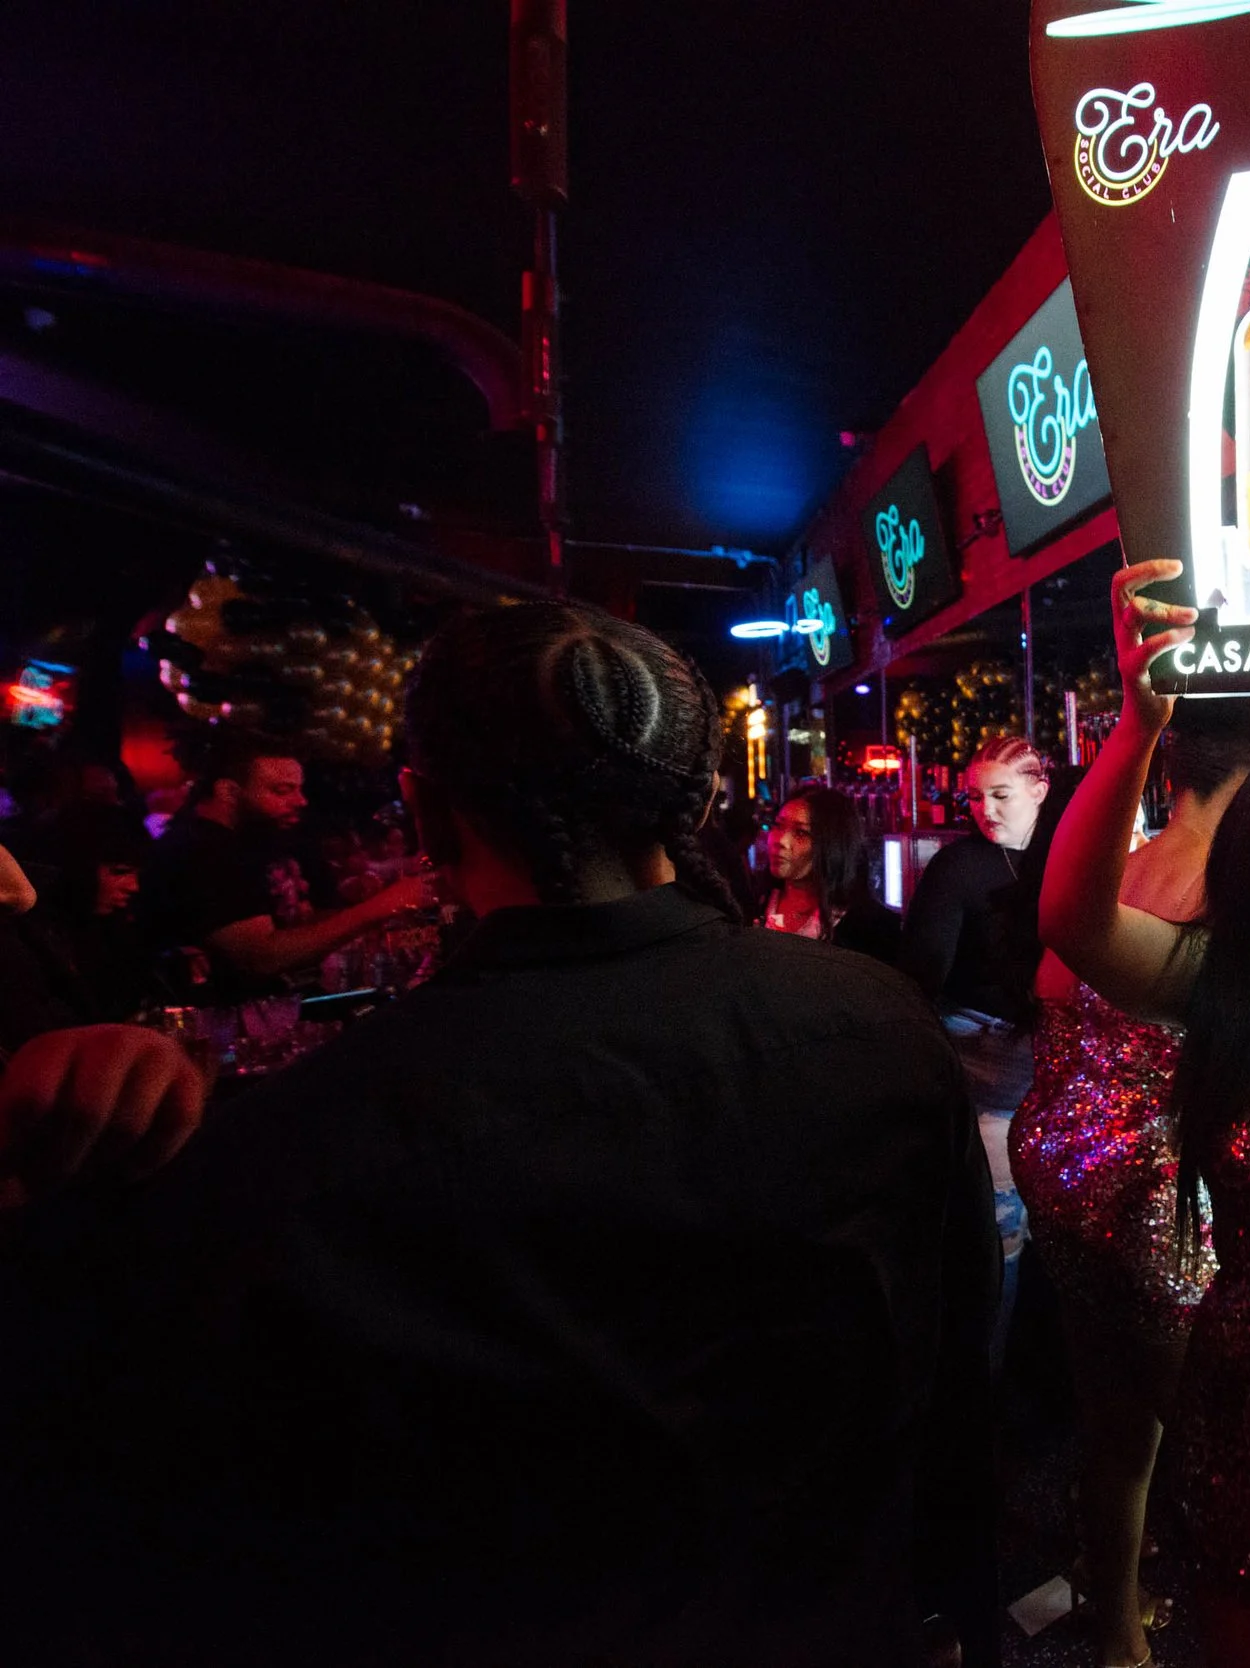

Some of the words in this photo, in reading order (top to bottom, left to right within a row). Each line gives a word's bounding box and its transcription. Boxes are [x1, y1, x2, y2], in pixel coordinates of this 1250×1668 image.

[1075, 82, 1221, 181] Era
[1079, 138, 1110, 200] SOCIAL
[1122, 162, 1161, 199] CLUB
